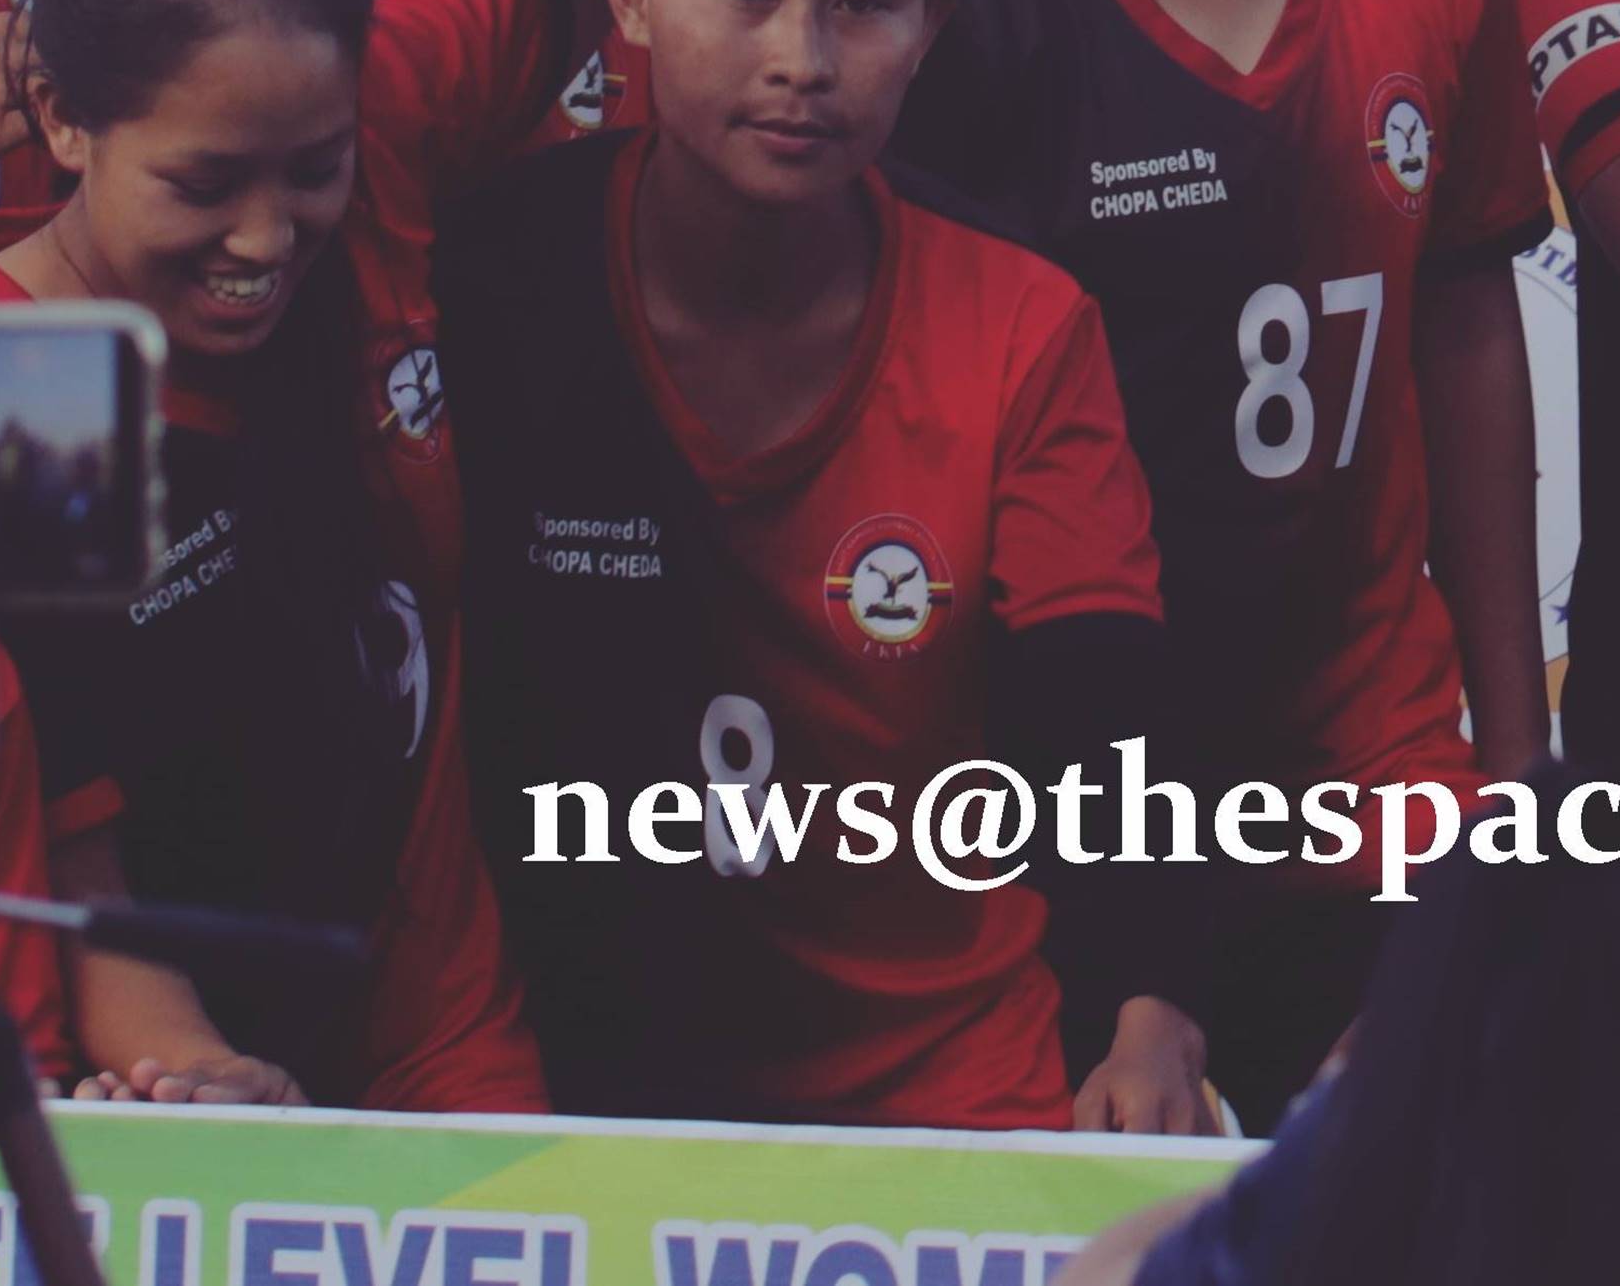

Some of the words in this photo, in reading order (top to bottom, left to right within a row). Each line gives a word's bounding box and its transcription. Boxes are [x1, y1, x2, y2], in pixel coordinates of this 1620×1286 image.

[1090, 148, 1190, 188] Sponsored
[1192, 147, 1217, 173] By
[1090, 189, 1159, 219] CHOPA
[1162, 179, 1228, 209] CHEDA
[1235, 272, 1383, 479] 87
[639, 517, 661, 546] By
[599, 551, 662, 579] CHEDA
[129, 574, 199, 625] CHOPA
